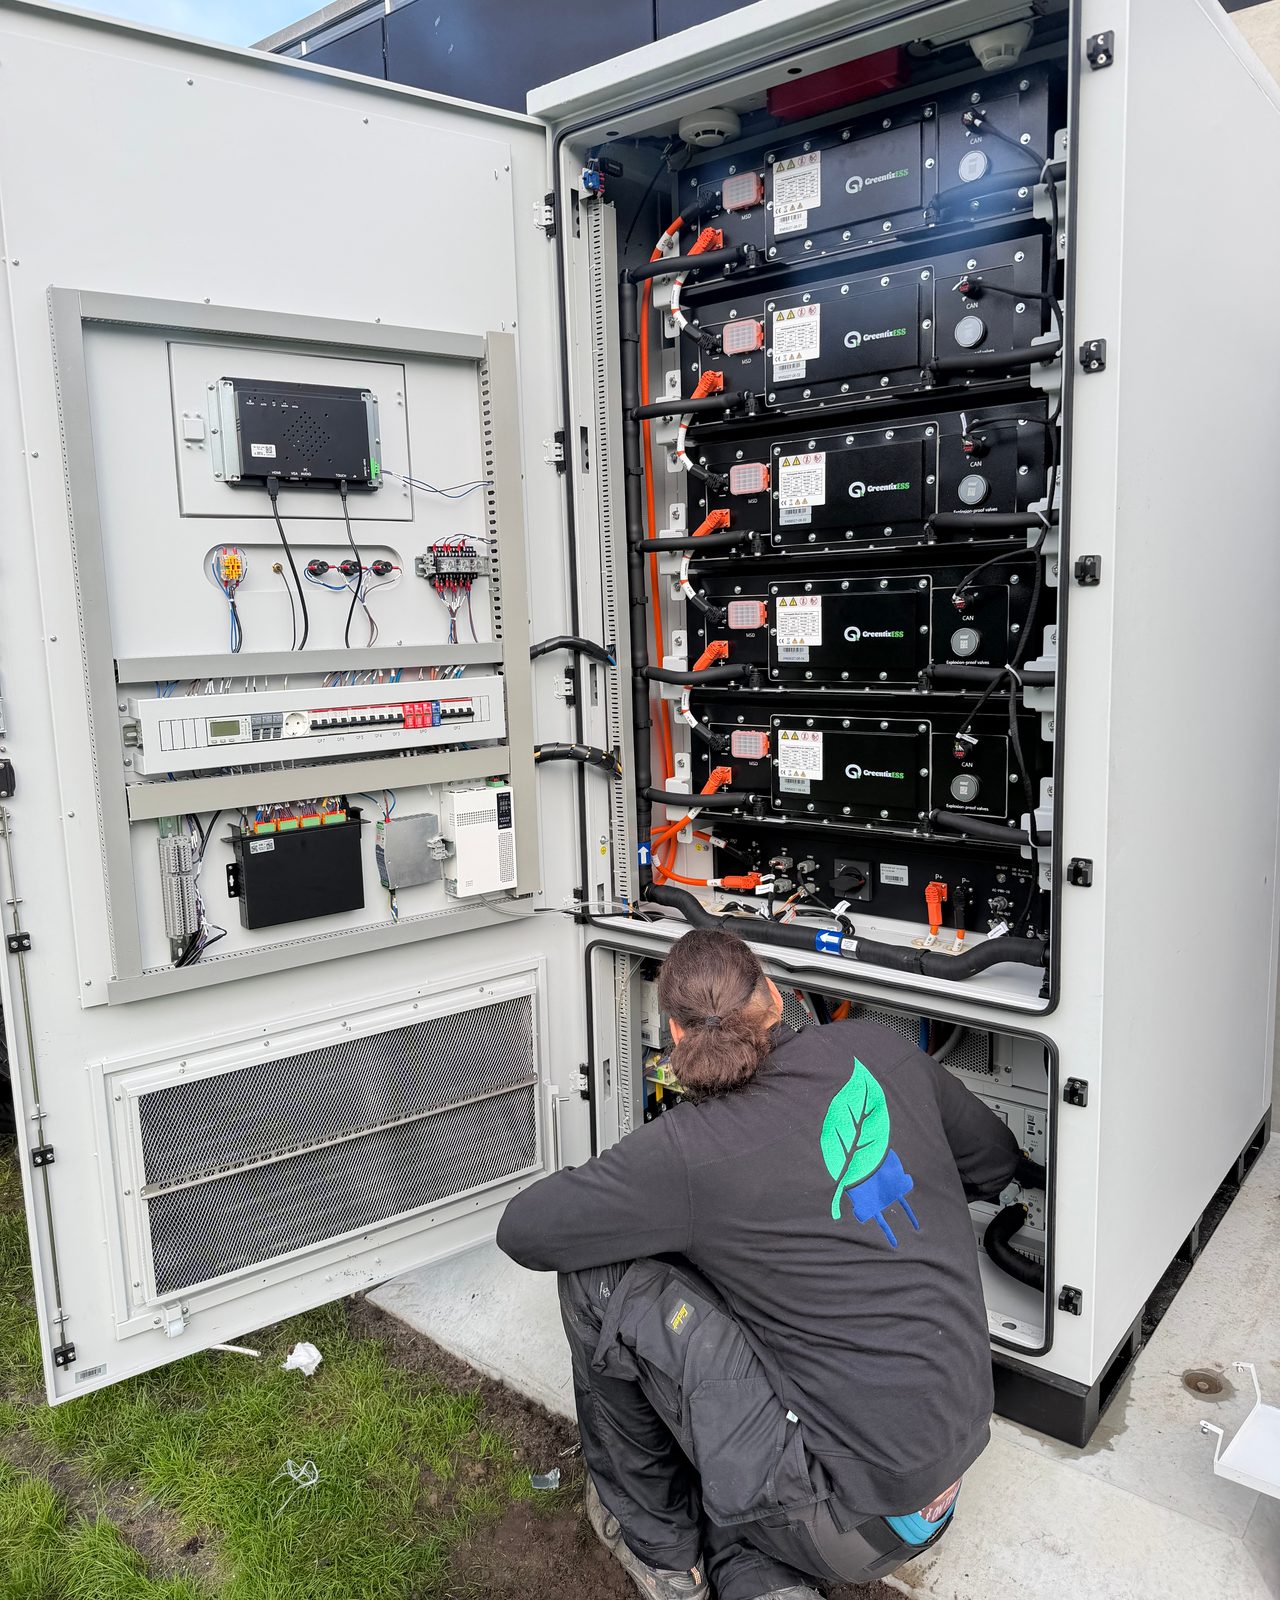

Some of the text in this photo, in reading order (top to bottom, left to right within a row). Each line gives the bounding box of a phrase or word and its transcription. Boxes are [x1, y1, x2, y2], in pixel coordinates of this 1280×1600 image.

[969, 136, 983, 145] CAN
[864, 168, 909, 185] GreentixESS
[965, 302, 979, 310] CAN
[863, 327, 907, 341] GreentixESS
[969, 460, 983, 468] CAN
[867, 482, 910, 493] GreentixESS
[862, 630, 904, 639] GreentixESS
[863, 769, 905, 779] GreentixESS
